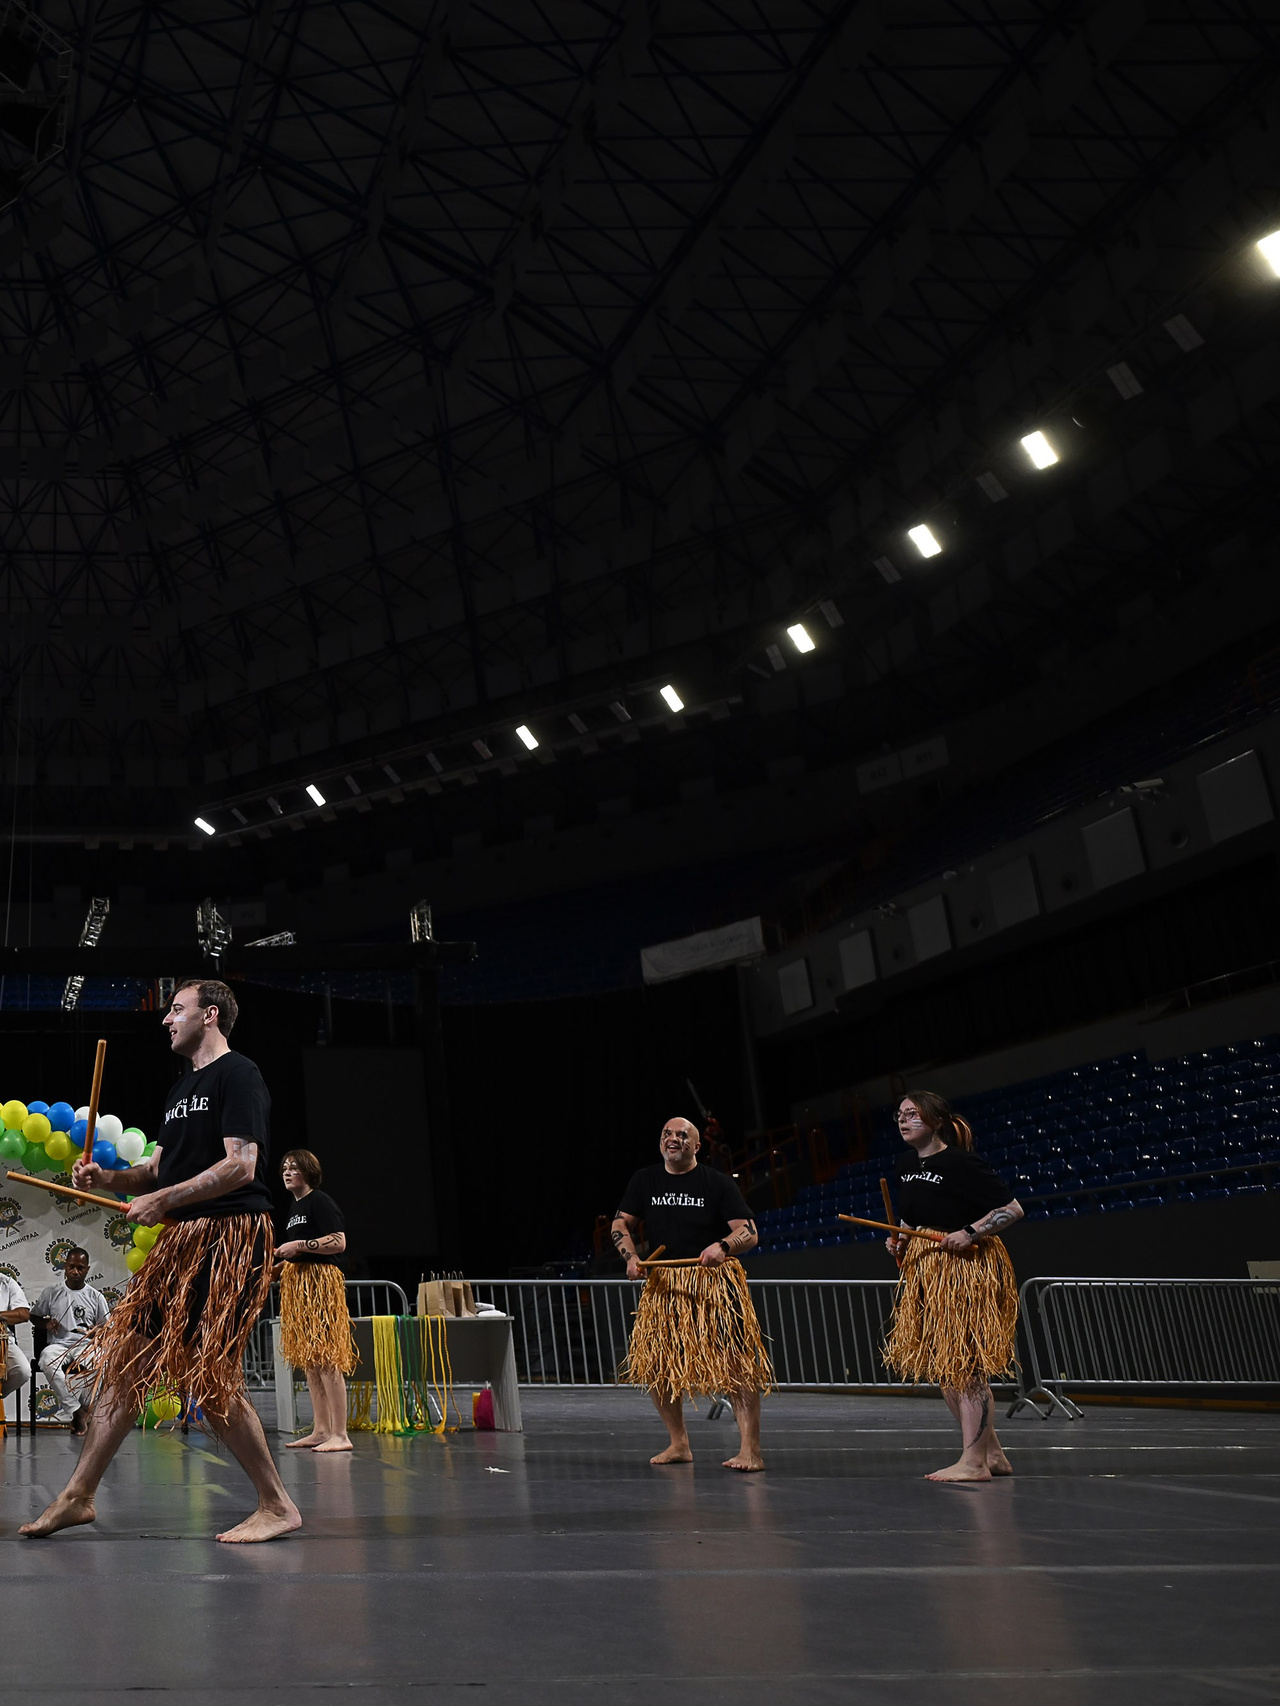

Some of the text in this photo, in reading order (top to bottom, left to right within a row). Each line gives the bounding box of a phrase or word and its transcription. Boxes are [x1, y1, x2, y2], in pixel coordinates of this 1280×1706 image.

[7, 1197, 22, 1211] OURO
[651, 1196, 705, 1208] MACULELE
[60, 1206, 102, 1226] КАЛИНИНГРАД
[103, 1215, 116, 1240] CORDÃO
[44, 1240, 57, 1264] CORDÃO
[65, 1238, 78, 1249] OUR
[6, 1262, 21, 1277] OURO
